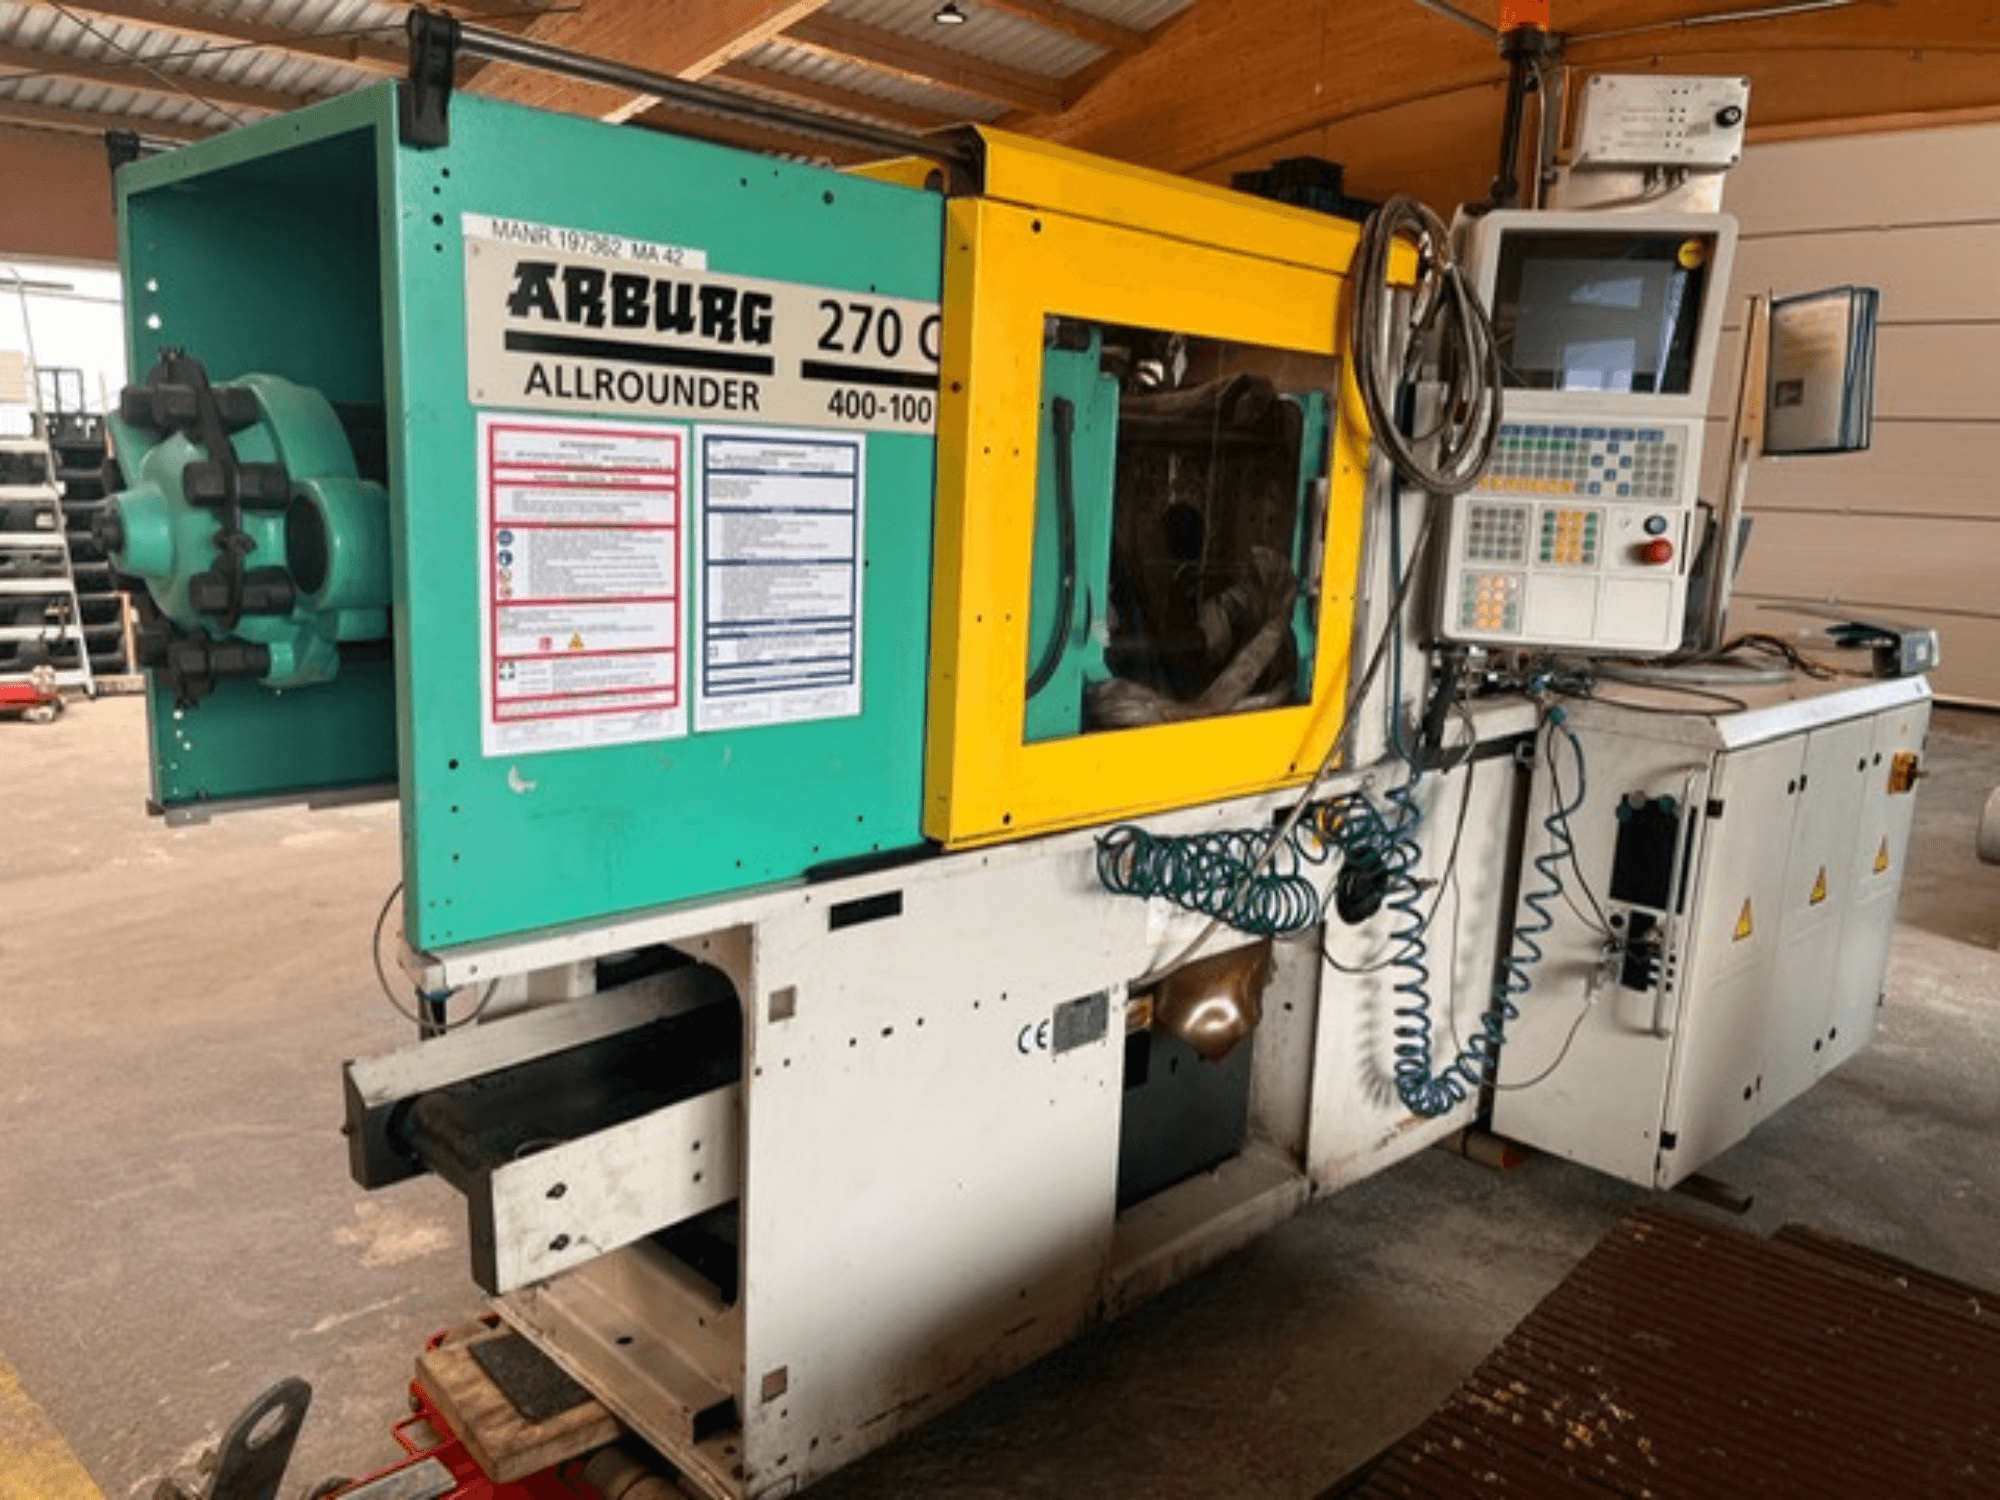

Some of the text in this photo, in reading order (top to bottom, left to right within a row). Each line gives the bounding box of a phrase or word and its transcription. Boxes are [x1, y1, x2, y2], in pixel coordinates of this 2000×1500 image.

[662, 247, 684, 267] 42
[507, 261, 774, 345] ARBURG
[818, 299, 902, 358] 270
[524, 363, 760, 412] ALLROUNDER
[827, 389, 932, 424] 400-100
